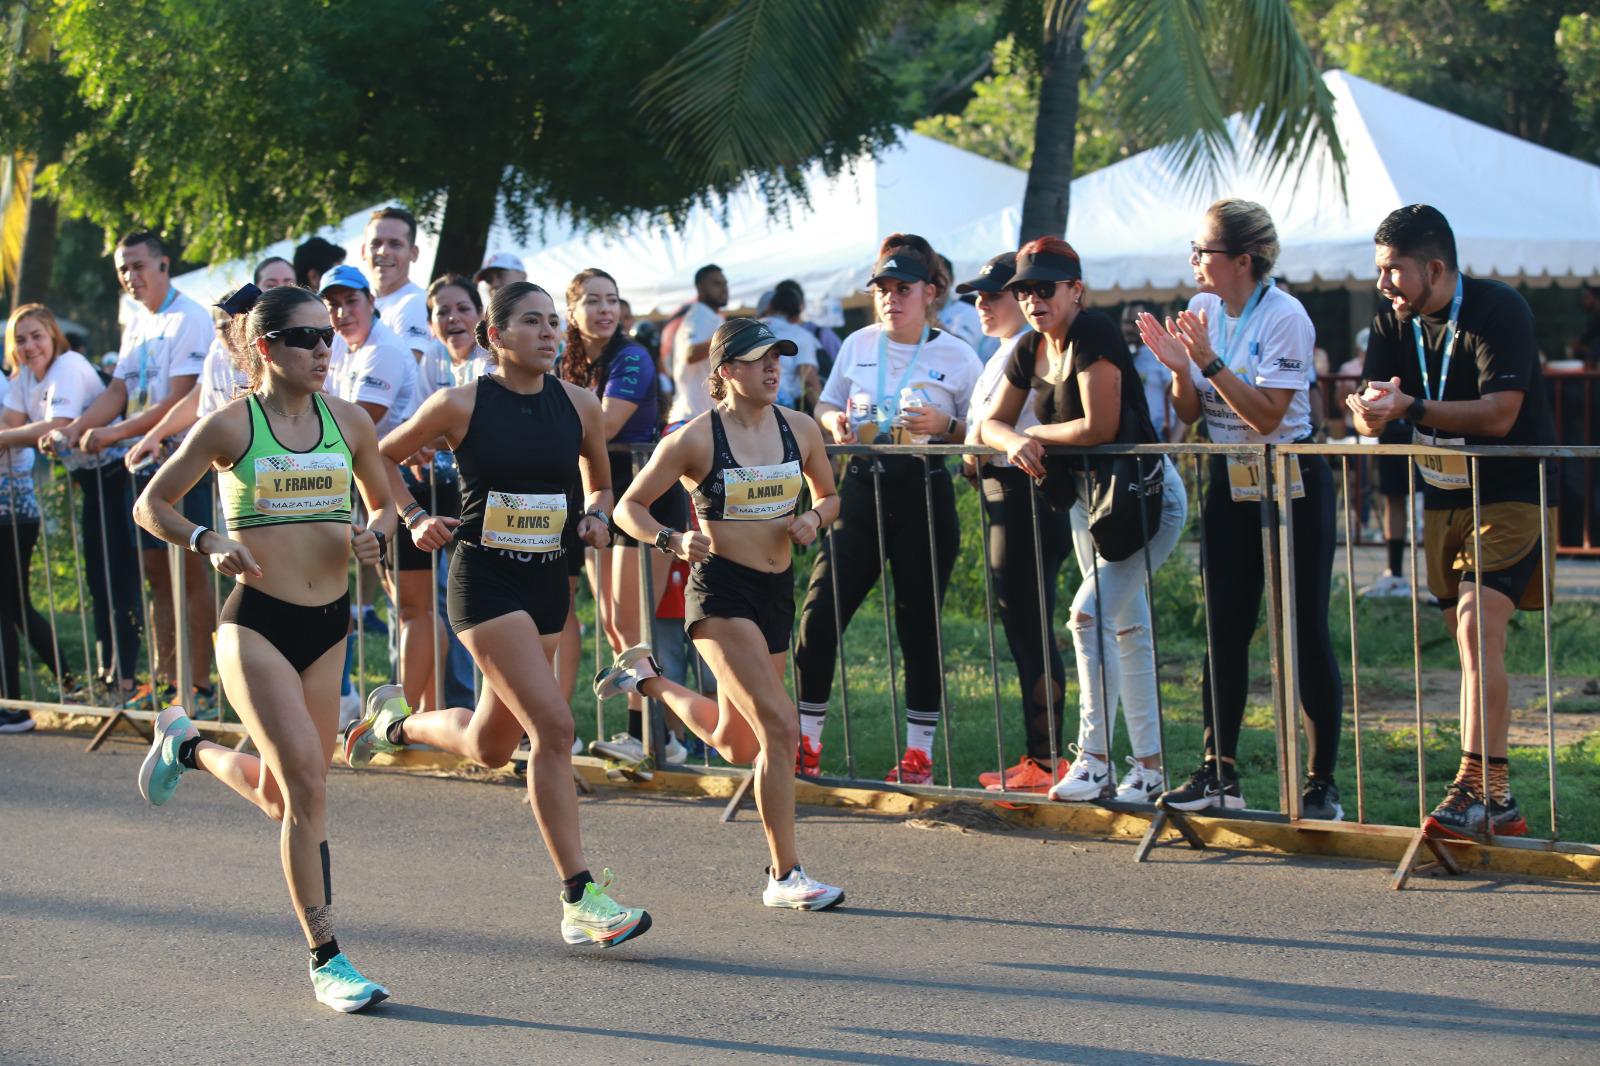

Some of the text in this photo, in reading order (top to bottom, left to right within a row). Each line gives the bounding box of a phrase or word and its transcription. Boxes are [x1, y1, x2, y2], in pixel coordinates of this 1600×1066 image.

[273, 475, 333, 492] Y. FRANCO
[747, 484, 784, 500] A.NAVA
[506, 515, 550, 529] Y. RIVAS
